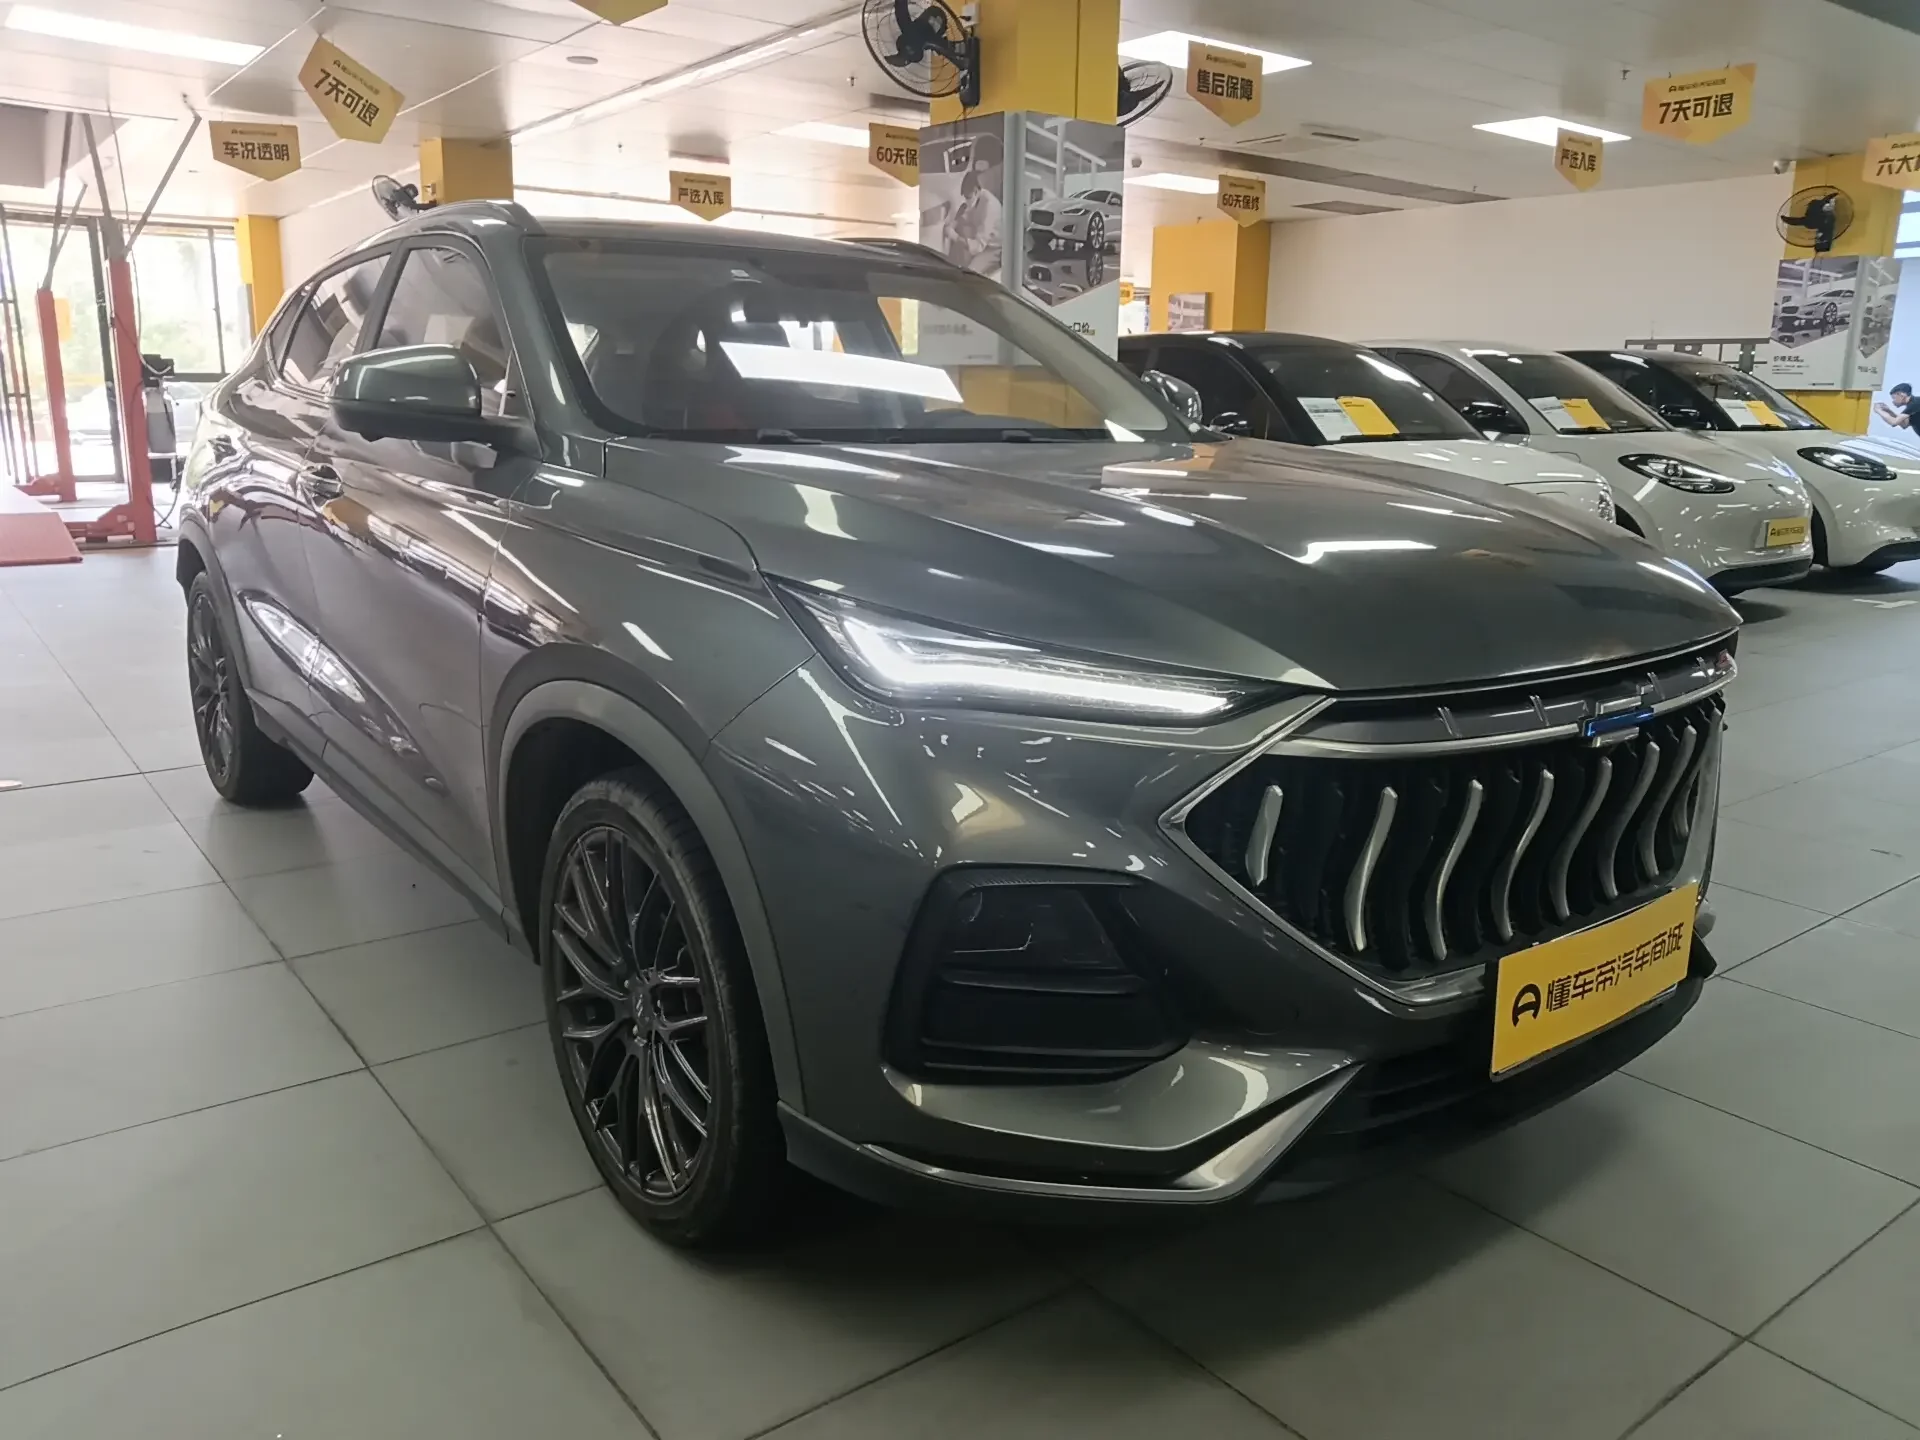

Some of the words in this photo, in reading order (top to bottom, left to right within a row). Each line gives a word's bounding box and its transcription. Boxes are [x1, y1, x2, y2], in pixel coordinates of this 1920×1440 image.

[314, 68, 380, 127] 7天可退
[1197, 69, 1253, 101] 售后保障
[1659, 93, 1734, 124] 7天可退
[223, 141, 290, 161] 车况透明
[1561, 148, 1596, 172] 严选入库
[1876, 154, 1920, 176] 六大
[678, 187, 724, 205] 严选入库
[1546, 922, 1684, 1012] 懂车帝汽车商城
